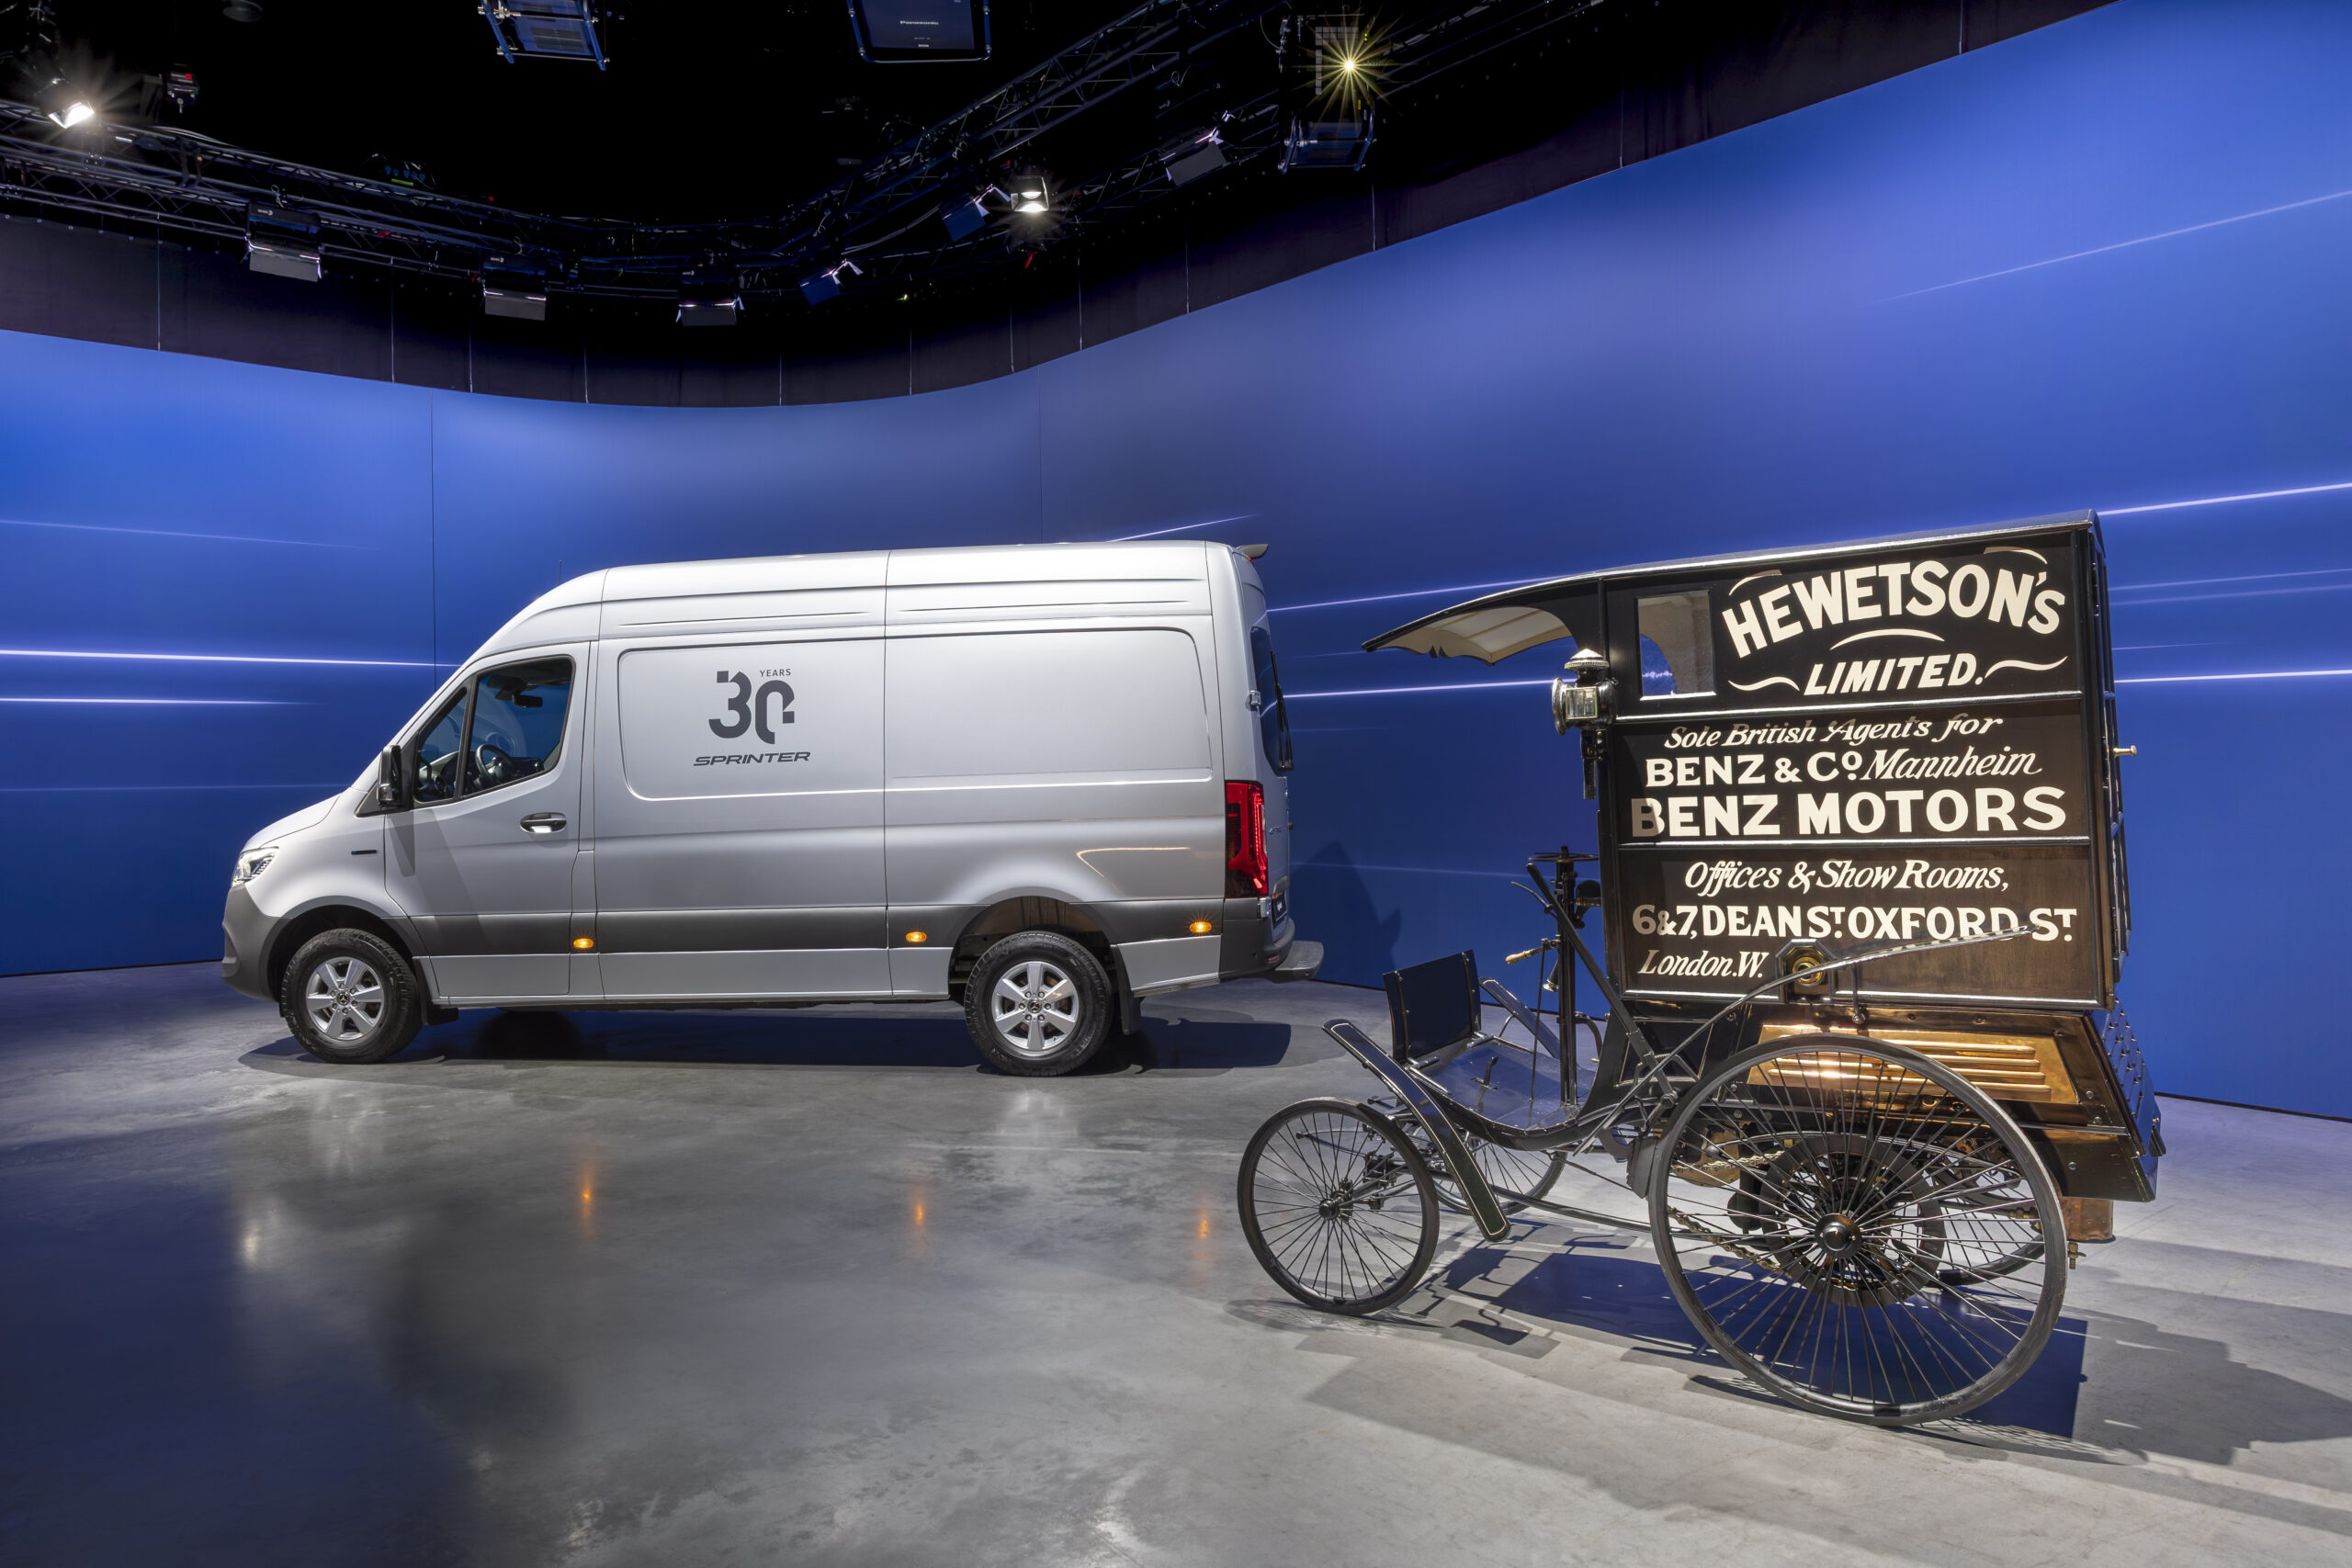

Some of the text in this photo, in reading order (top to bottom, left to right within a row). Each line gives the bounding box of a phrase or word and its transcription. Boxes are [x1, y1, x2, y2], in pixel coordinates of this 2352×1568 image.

[759, 668, 792, 678] YEARS
[1804, 652, 1984, 696] LIMITED.
[708, 670, 796, 745] 30
[1664, 712, 2005, 750] Sole British Agents for
[693, 751, 811, 767] SPRINTER
[1645, 753, 1767, 788] BENZ
[1773, 757, 1804, 784] &
[1859, 745, 2043, 782] Mannheim
[1631, 786, 2067, 838] BENZ MOTORS
[1684, 858, 2010, 897] Offices & Show Rooms,
[1702, 905, 1803, 938] DEAN
[1848, 905, 2020, 942] OXFORD
